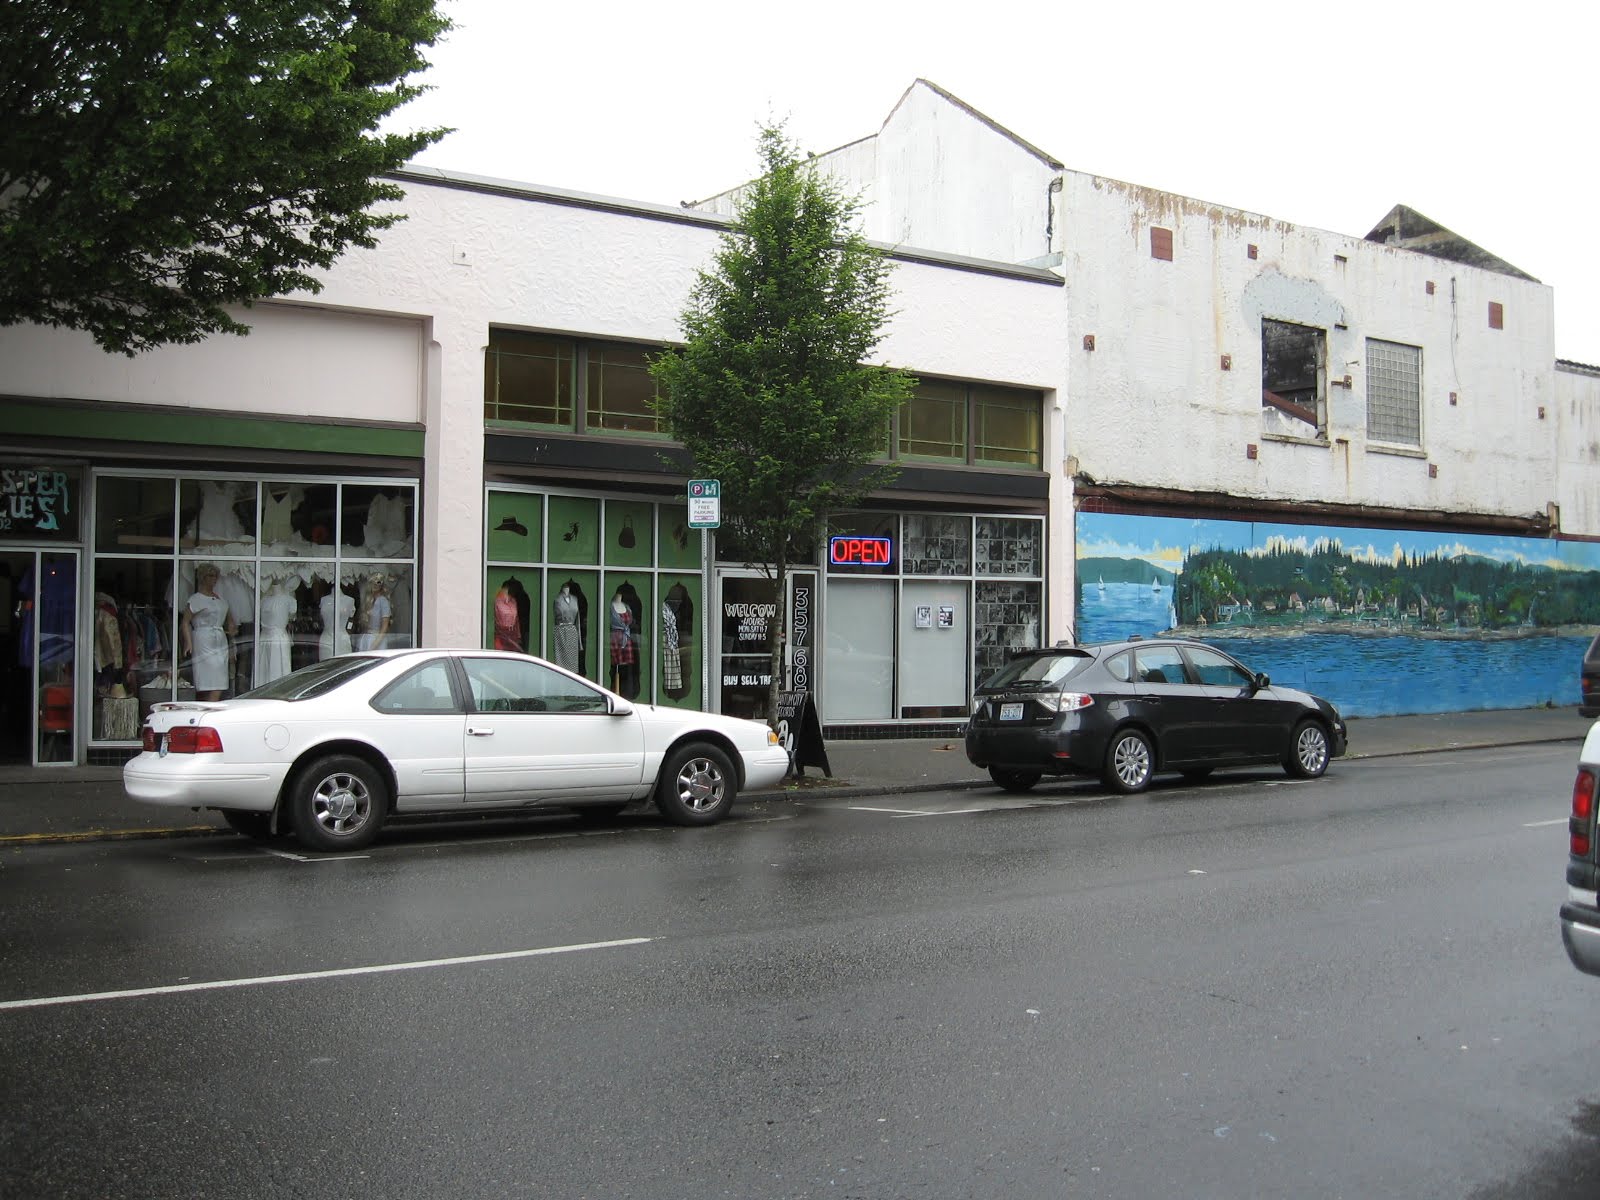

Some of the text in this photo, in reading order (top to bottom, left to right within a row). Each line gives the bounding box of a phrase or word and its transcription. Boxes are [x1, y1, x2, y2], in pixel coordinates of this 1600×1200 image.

[694, 485, 701, 494] P
[833, 540, 888, 562] OPEN
[724, 603, 776, 618] WELCOM
[738, 632, 758, 641] SUNDAY
[723, 675, 739, 686] BUY
[740, 675, 759, 686] SELL
